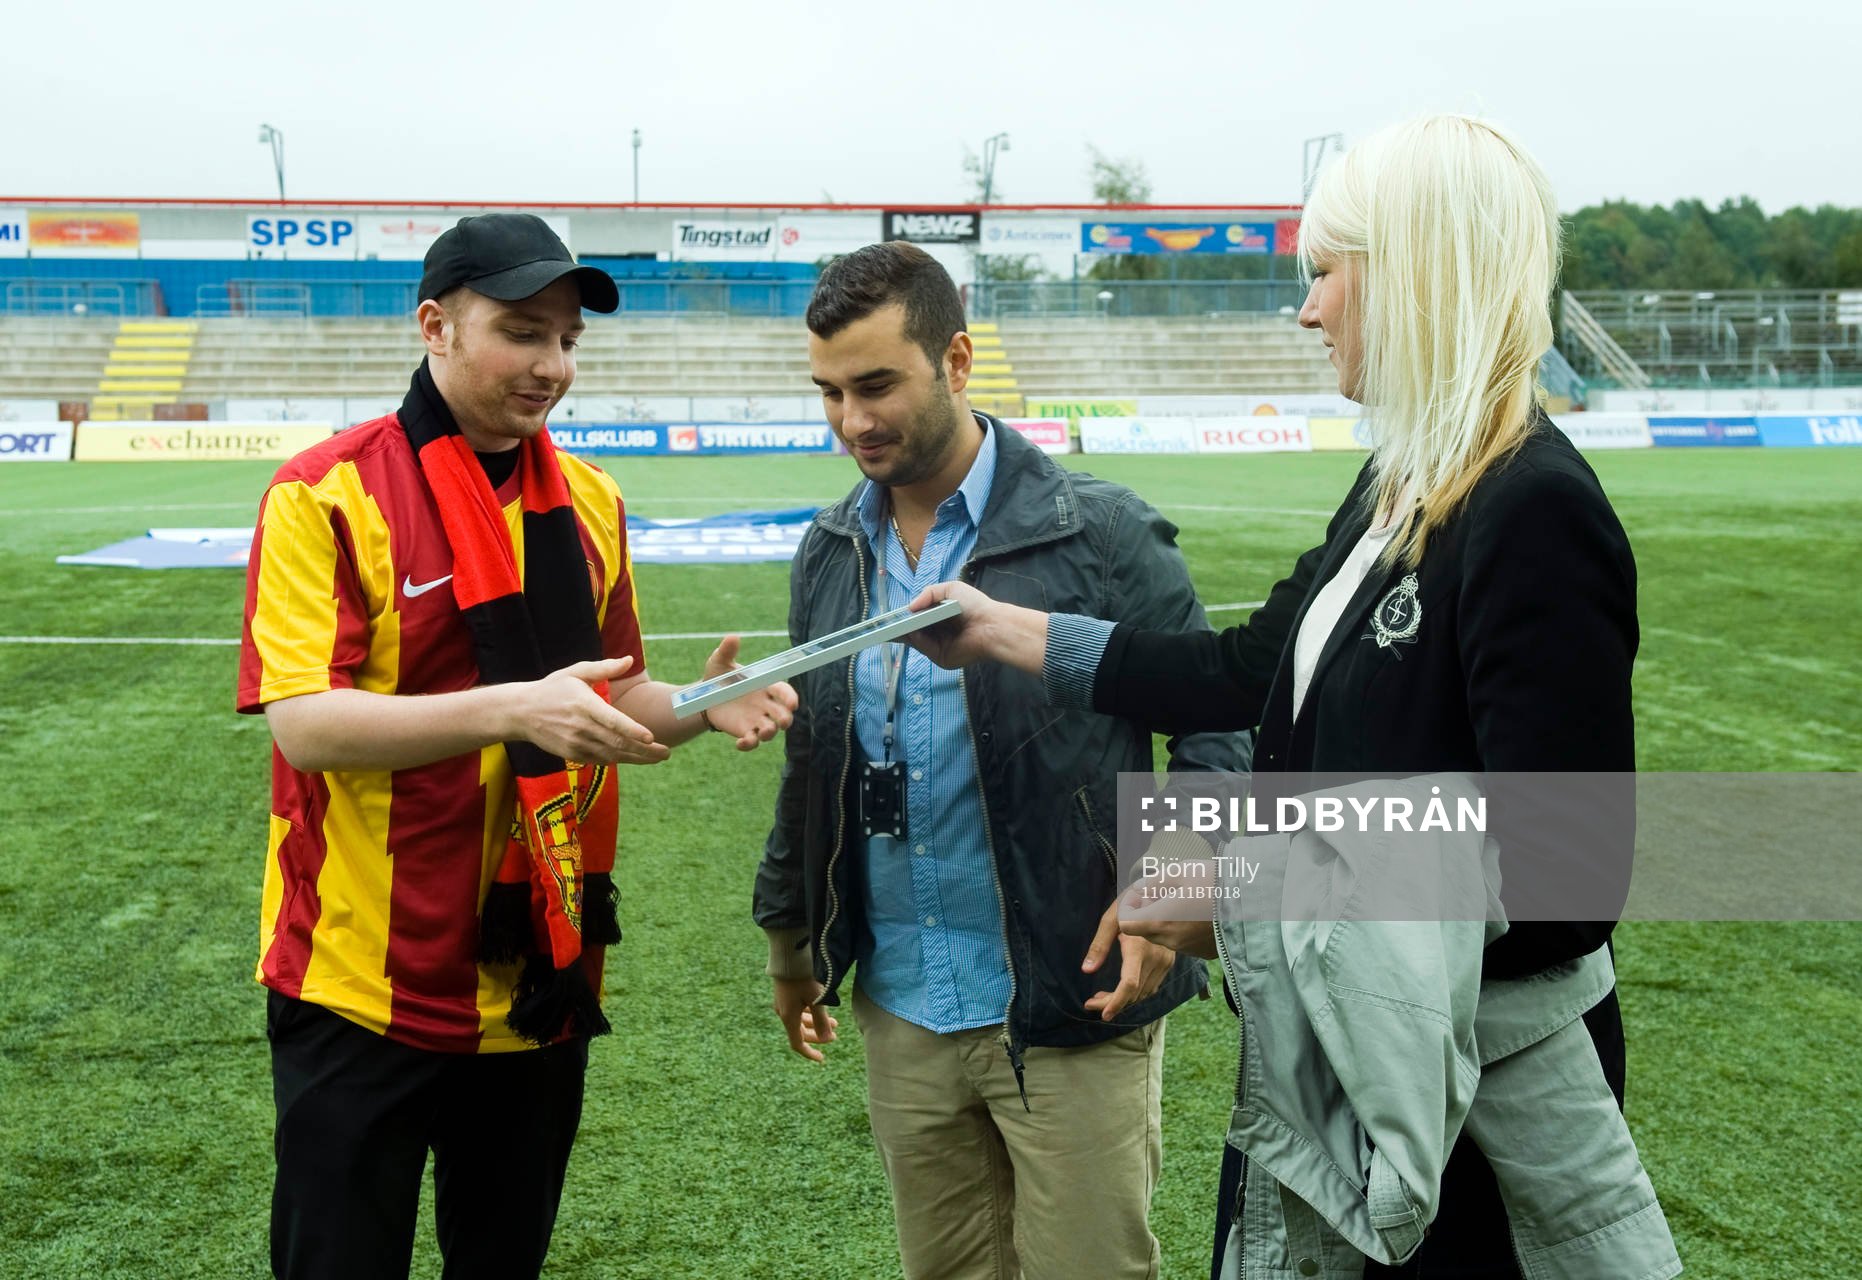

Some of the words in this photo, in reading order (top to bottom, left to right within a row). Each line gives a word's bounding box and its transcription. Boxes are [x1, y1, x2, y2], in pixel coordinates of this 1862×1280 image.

[679, 225, 771, 247] Tingstad
[130, 429, 281, 455] exchange
[549, 429, 659, 448] OLLSKLUBB
[702, 428, 826, 448] STRYKTIPSET
[1203, 429, 1304, 446] RICOH
